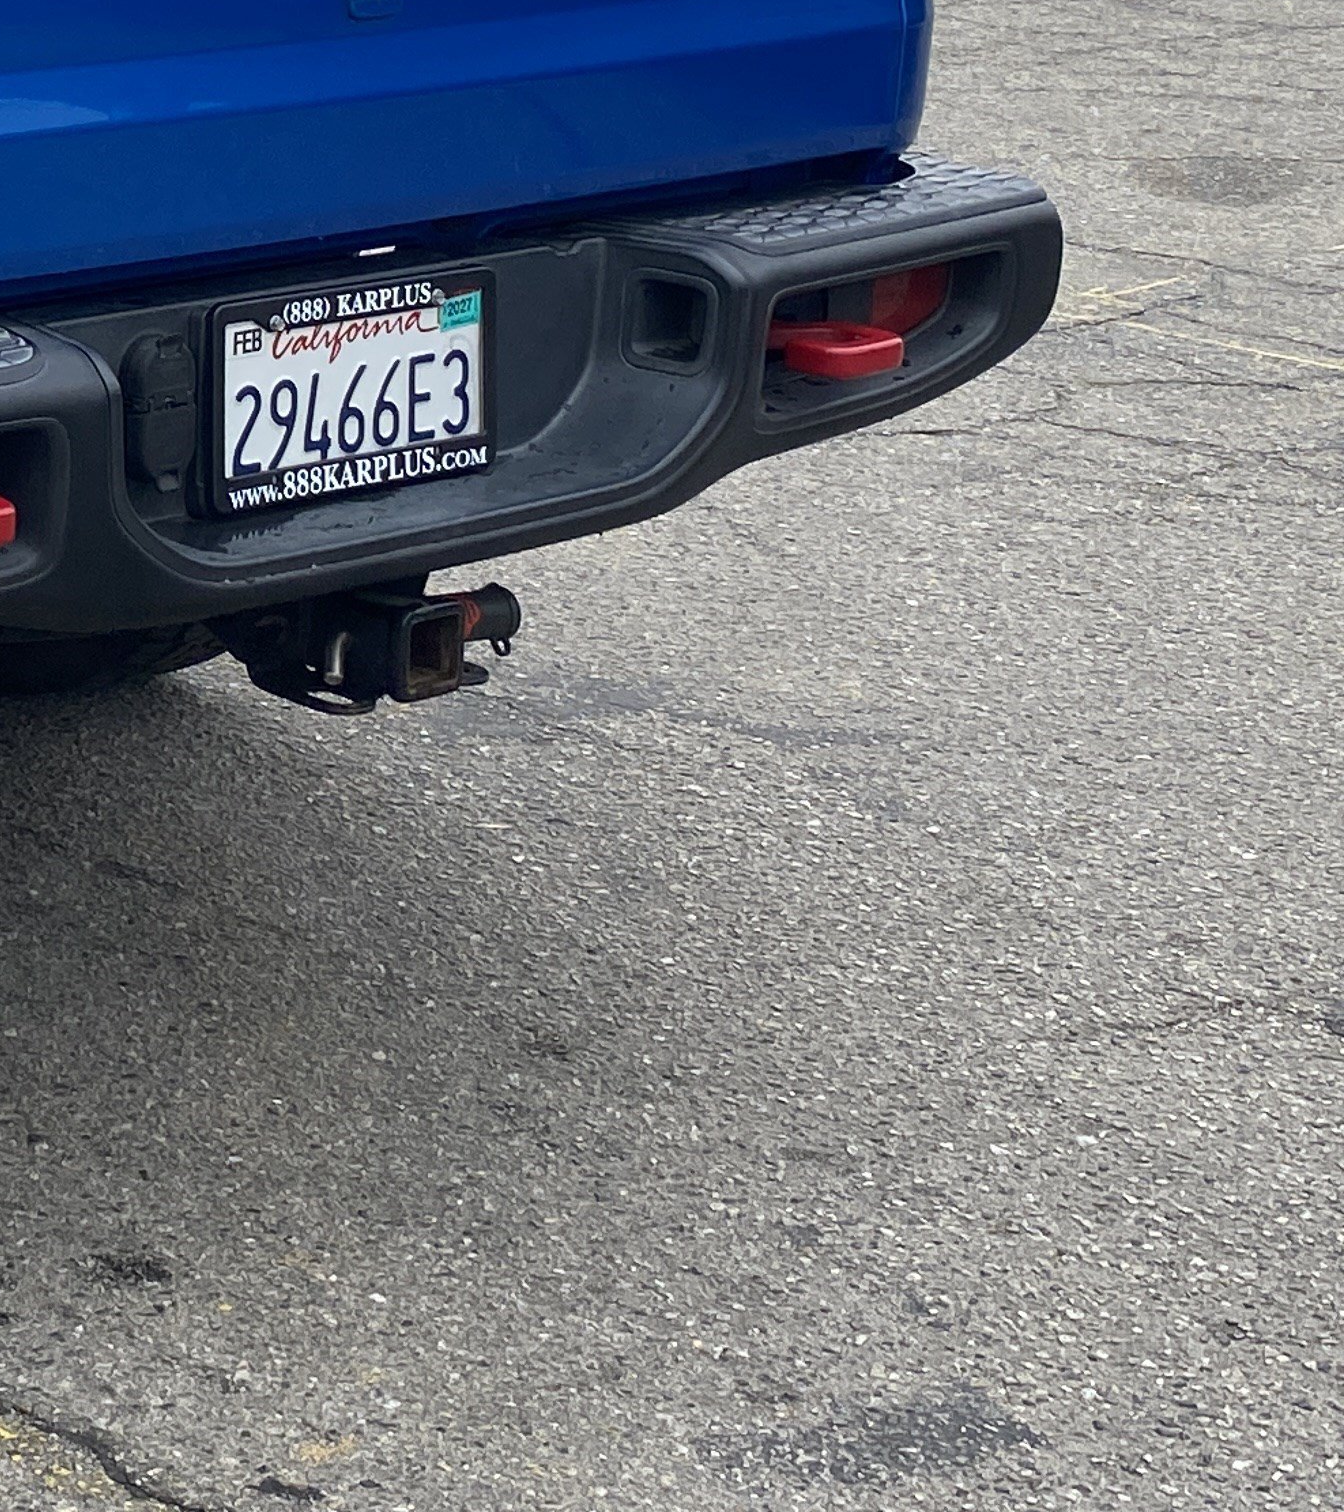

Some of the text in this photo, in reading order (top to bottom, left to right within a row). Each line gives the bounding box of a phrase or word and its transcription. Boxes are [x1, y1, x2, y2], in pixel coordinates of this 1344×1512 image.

[283, 282, 432, 324] (888) KARPLUS
[447, 296, 473, 317] 2027
[232, 328, 263, 356] FEB
[271, 310, 439, 364] California
[231, 348, 471, 477] 29466E3
